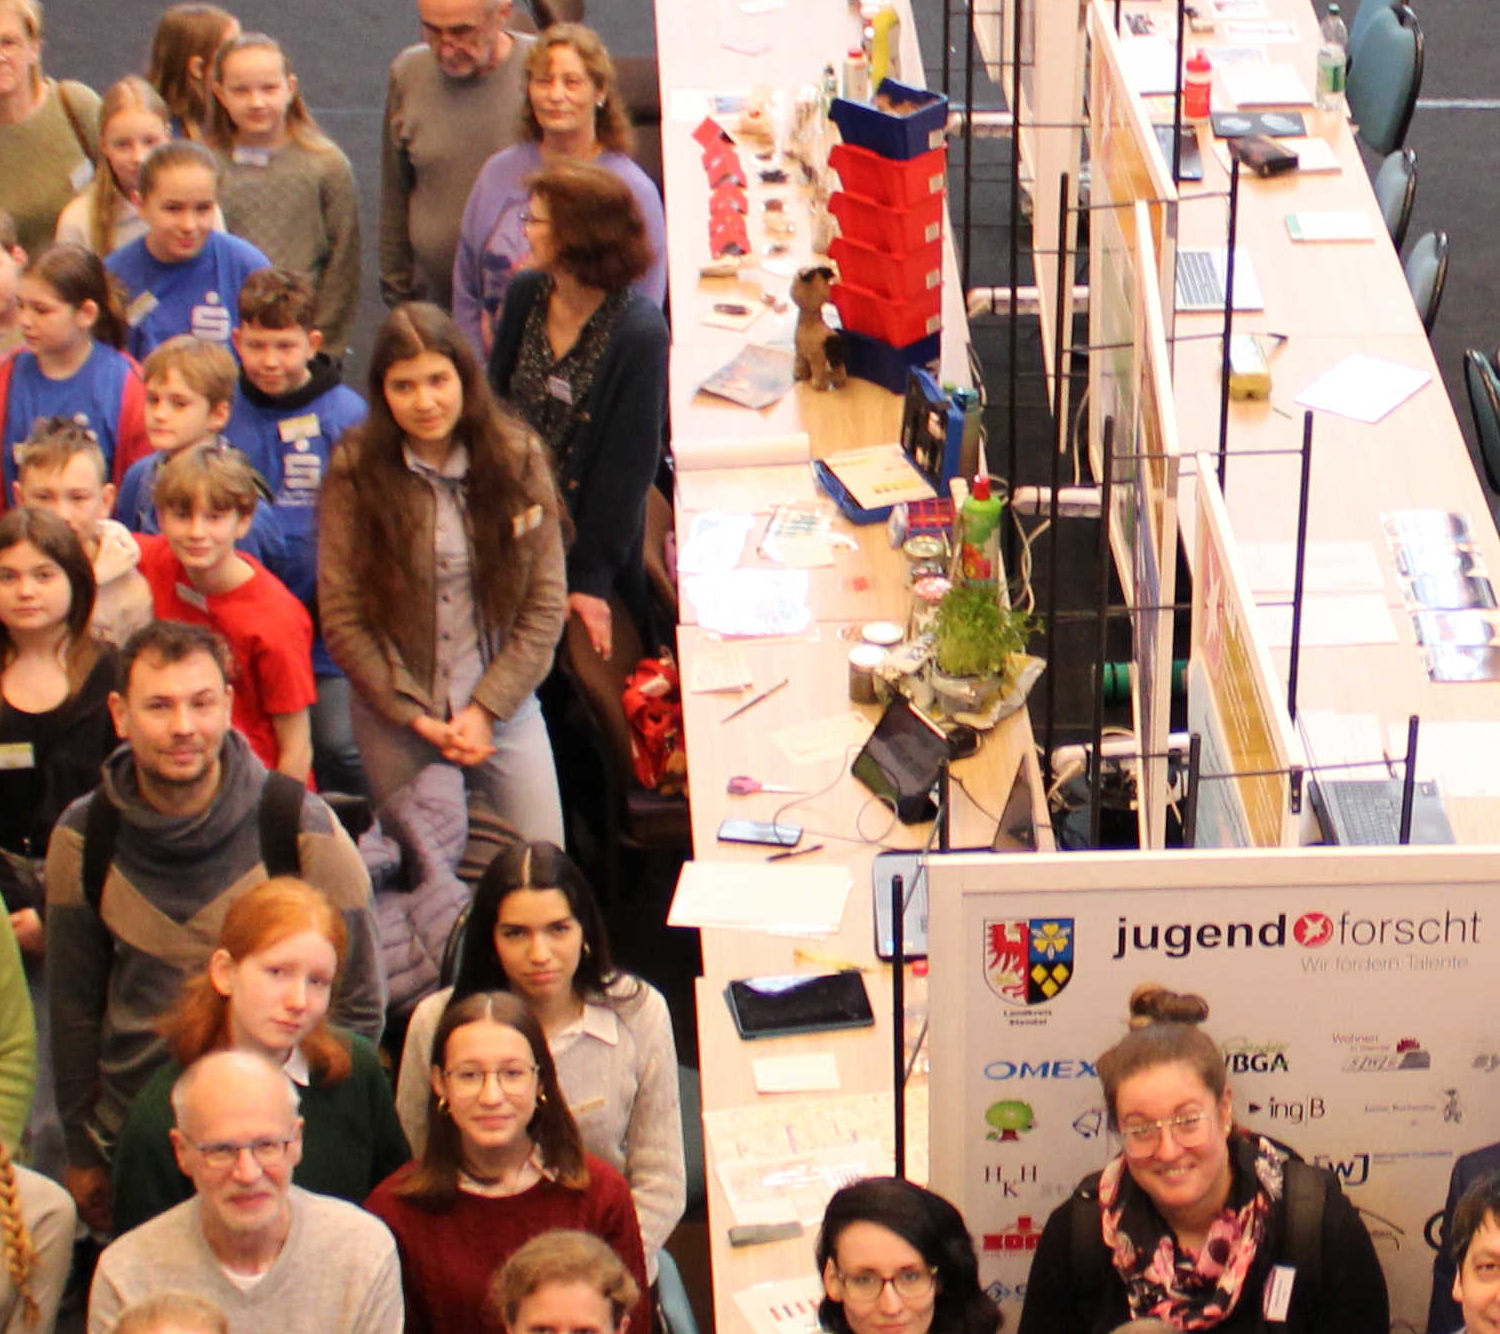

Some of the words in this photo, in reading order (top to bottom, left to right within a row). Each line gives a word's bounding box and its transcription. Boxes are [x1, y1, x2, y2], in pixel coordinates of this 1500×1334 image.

[1113, 913, 1287, 959] jugend
[1339, 911, 1482, 946] forscht
[1300, 955, 1328, 973] Wir
[1407, 954, 1470, 970] Talente
[1003, 1009, 1052, 1017] Landkreis
[984, 1060, 1099, 1081] OMEX
